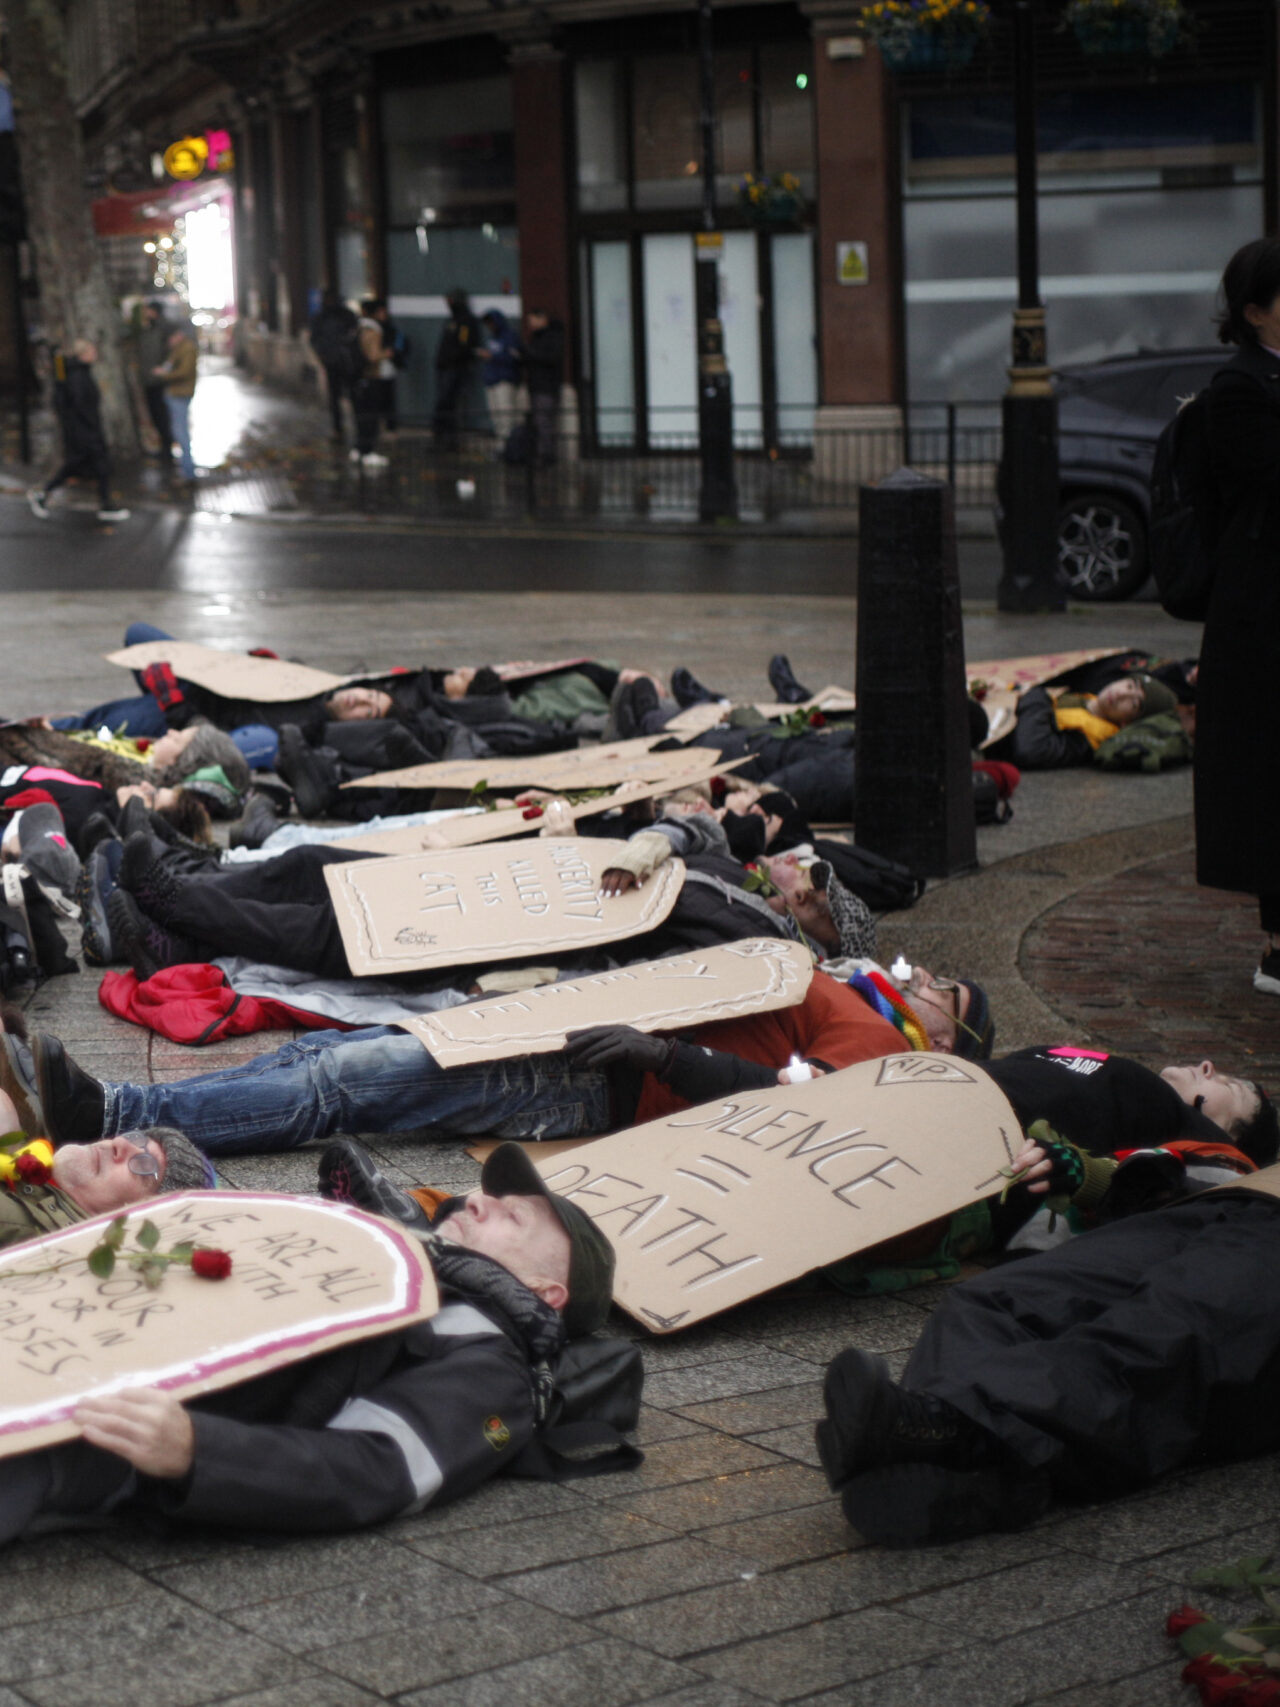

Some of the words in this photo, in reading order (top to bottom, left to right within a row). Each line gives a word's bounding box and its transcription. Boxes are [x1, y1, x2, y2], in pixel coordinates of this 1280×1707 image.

[419, 871, 466, 915] CAT
[474, 871, 504, 907] THIS
[506, 859, 551, 916] KILLED
[887, 1057, 949, 1078] RIP
[667, 1100, 922, 1210] SILENCE
[172, 1203, 261, 1232] WE
[239, 1231, 339, 1268] ARE
[301, 1266, 381, 1303] ALL
[50, 1296, 98, 1322] OR
[91, 1327, 134, 1348] IN
[96, 1278, 175, 1328] OUR
